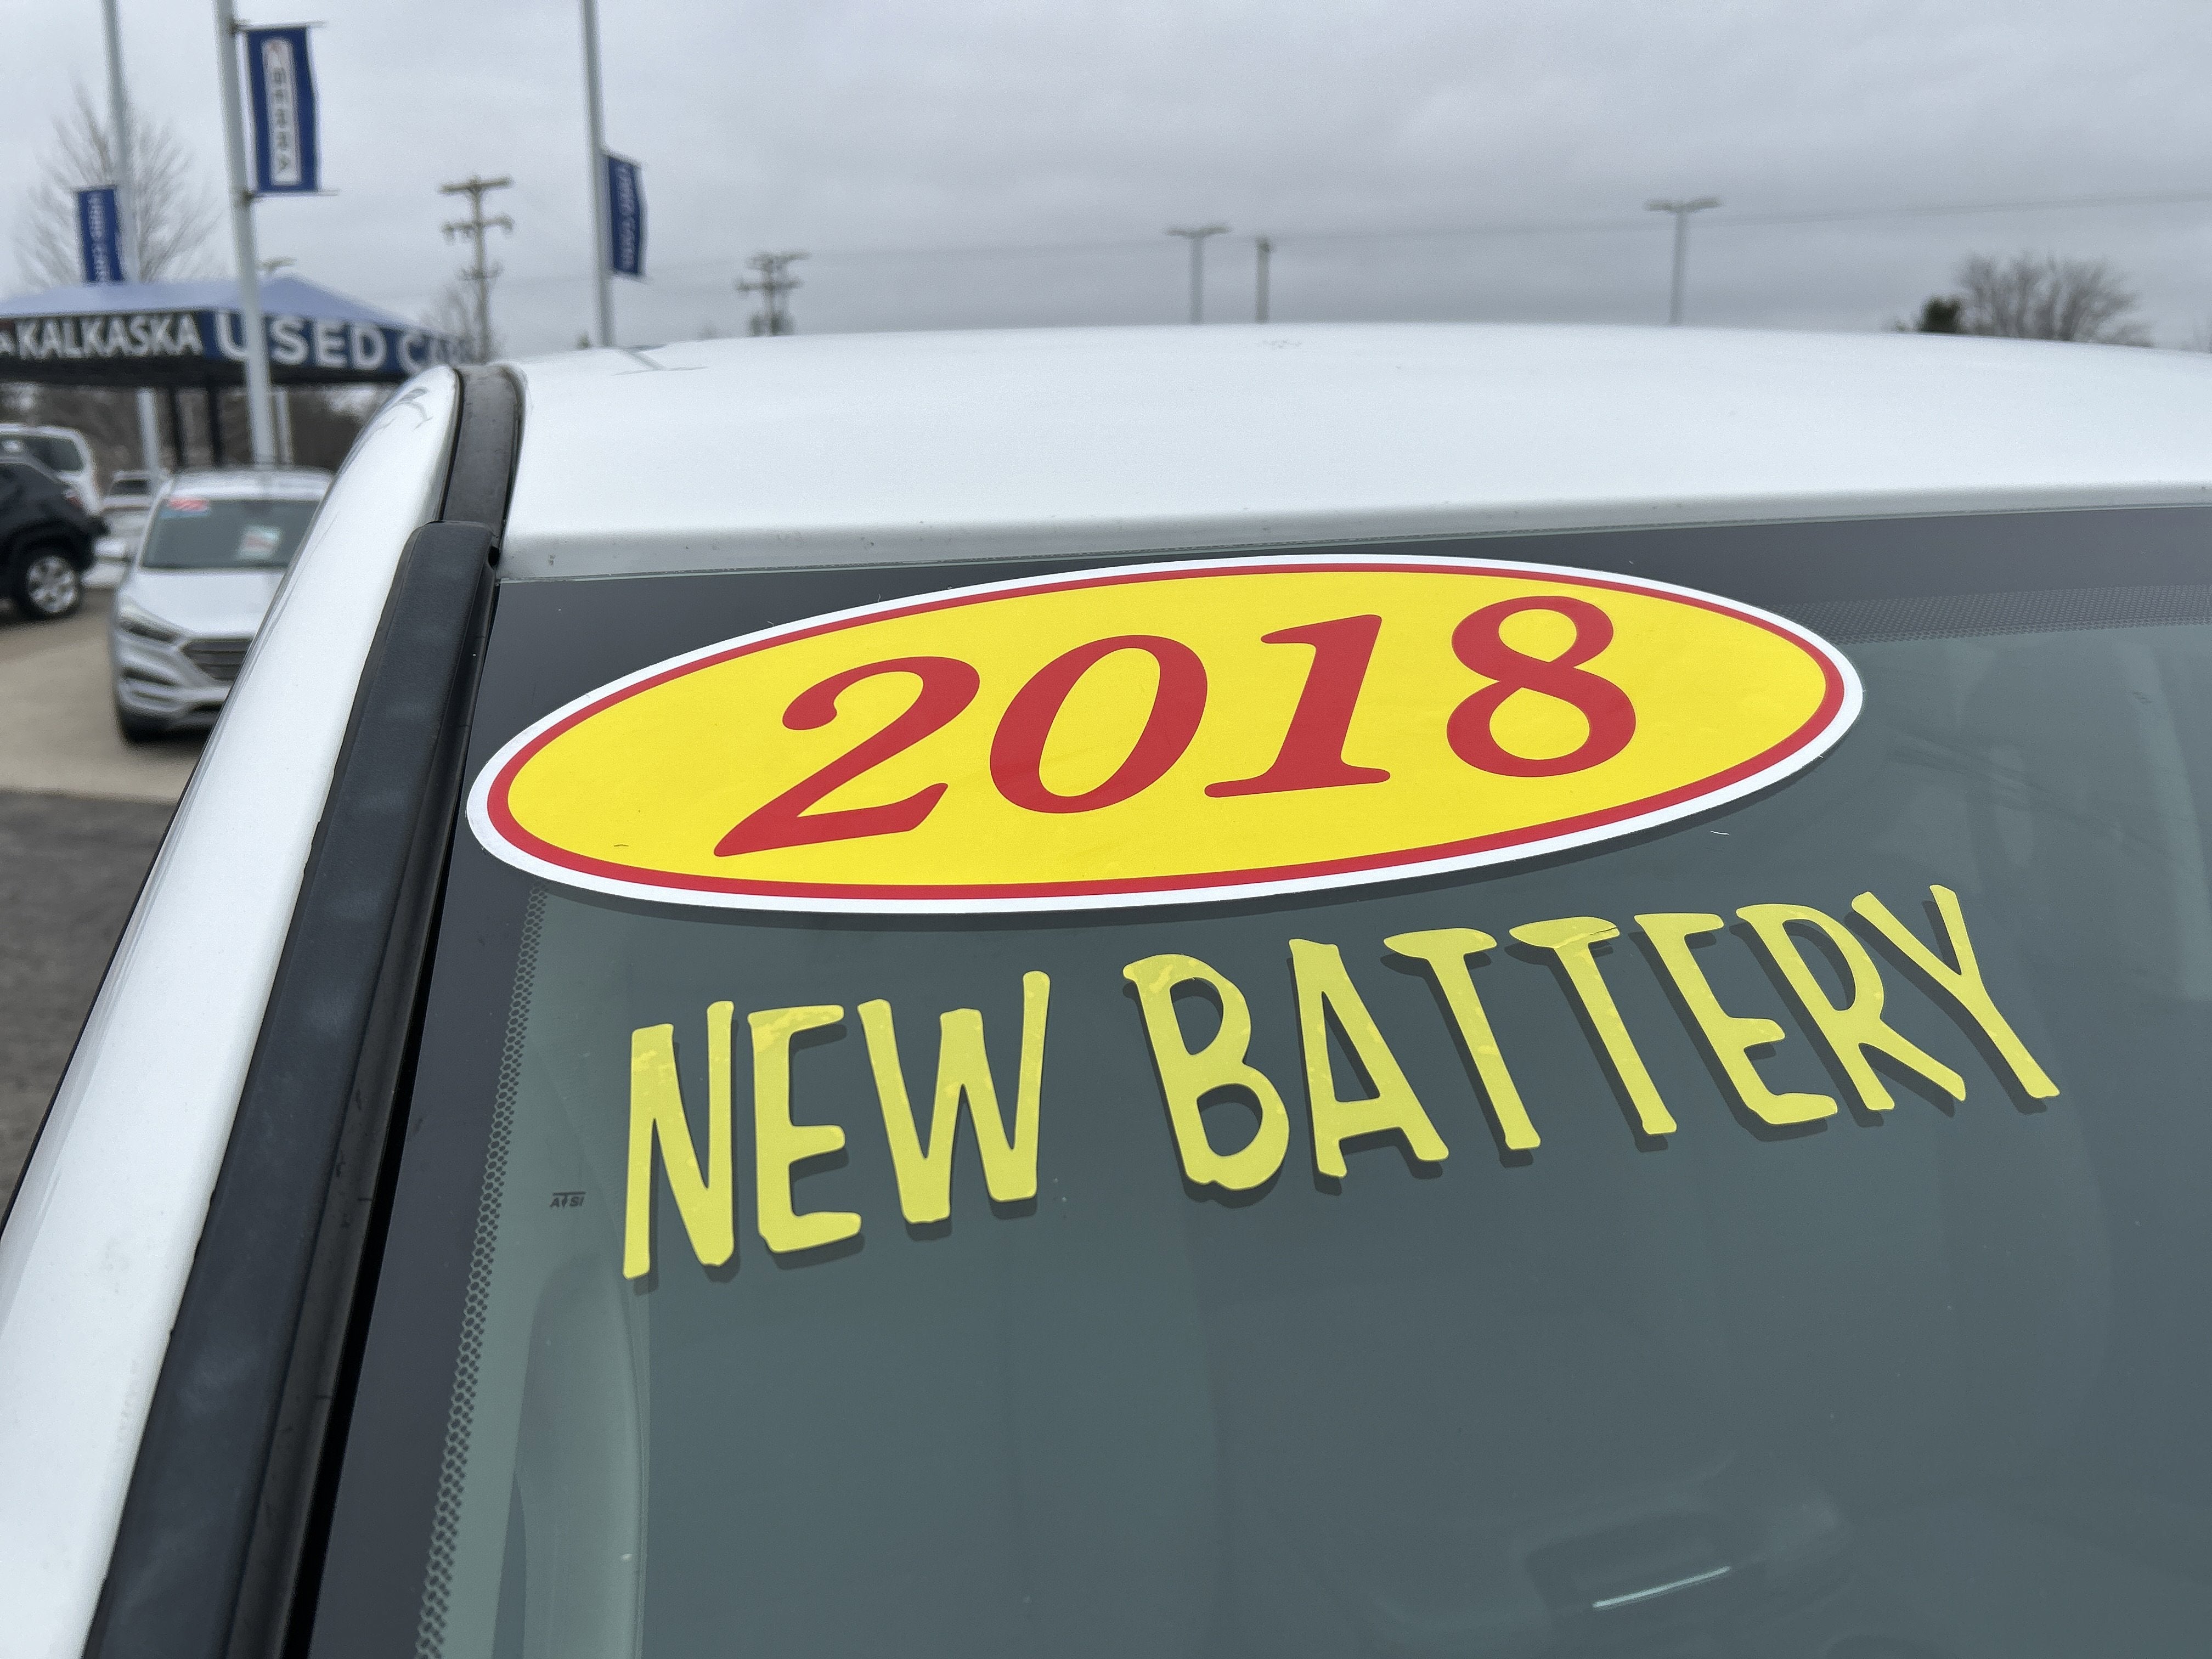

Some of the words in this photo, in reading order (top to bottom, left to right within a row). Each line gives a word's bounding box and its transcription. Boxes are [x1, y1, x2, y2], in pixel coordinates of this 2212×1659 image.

[16, 313, 203, 360] KALKASKA
[215, 308, 387, 371] USED
[715, 596, 1635, 856] 2018
[624, 972, 1049, 1281] NEW
[1124, 884, 2059, 1190] BATTERY
